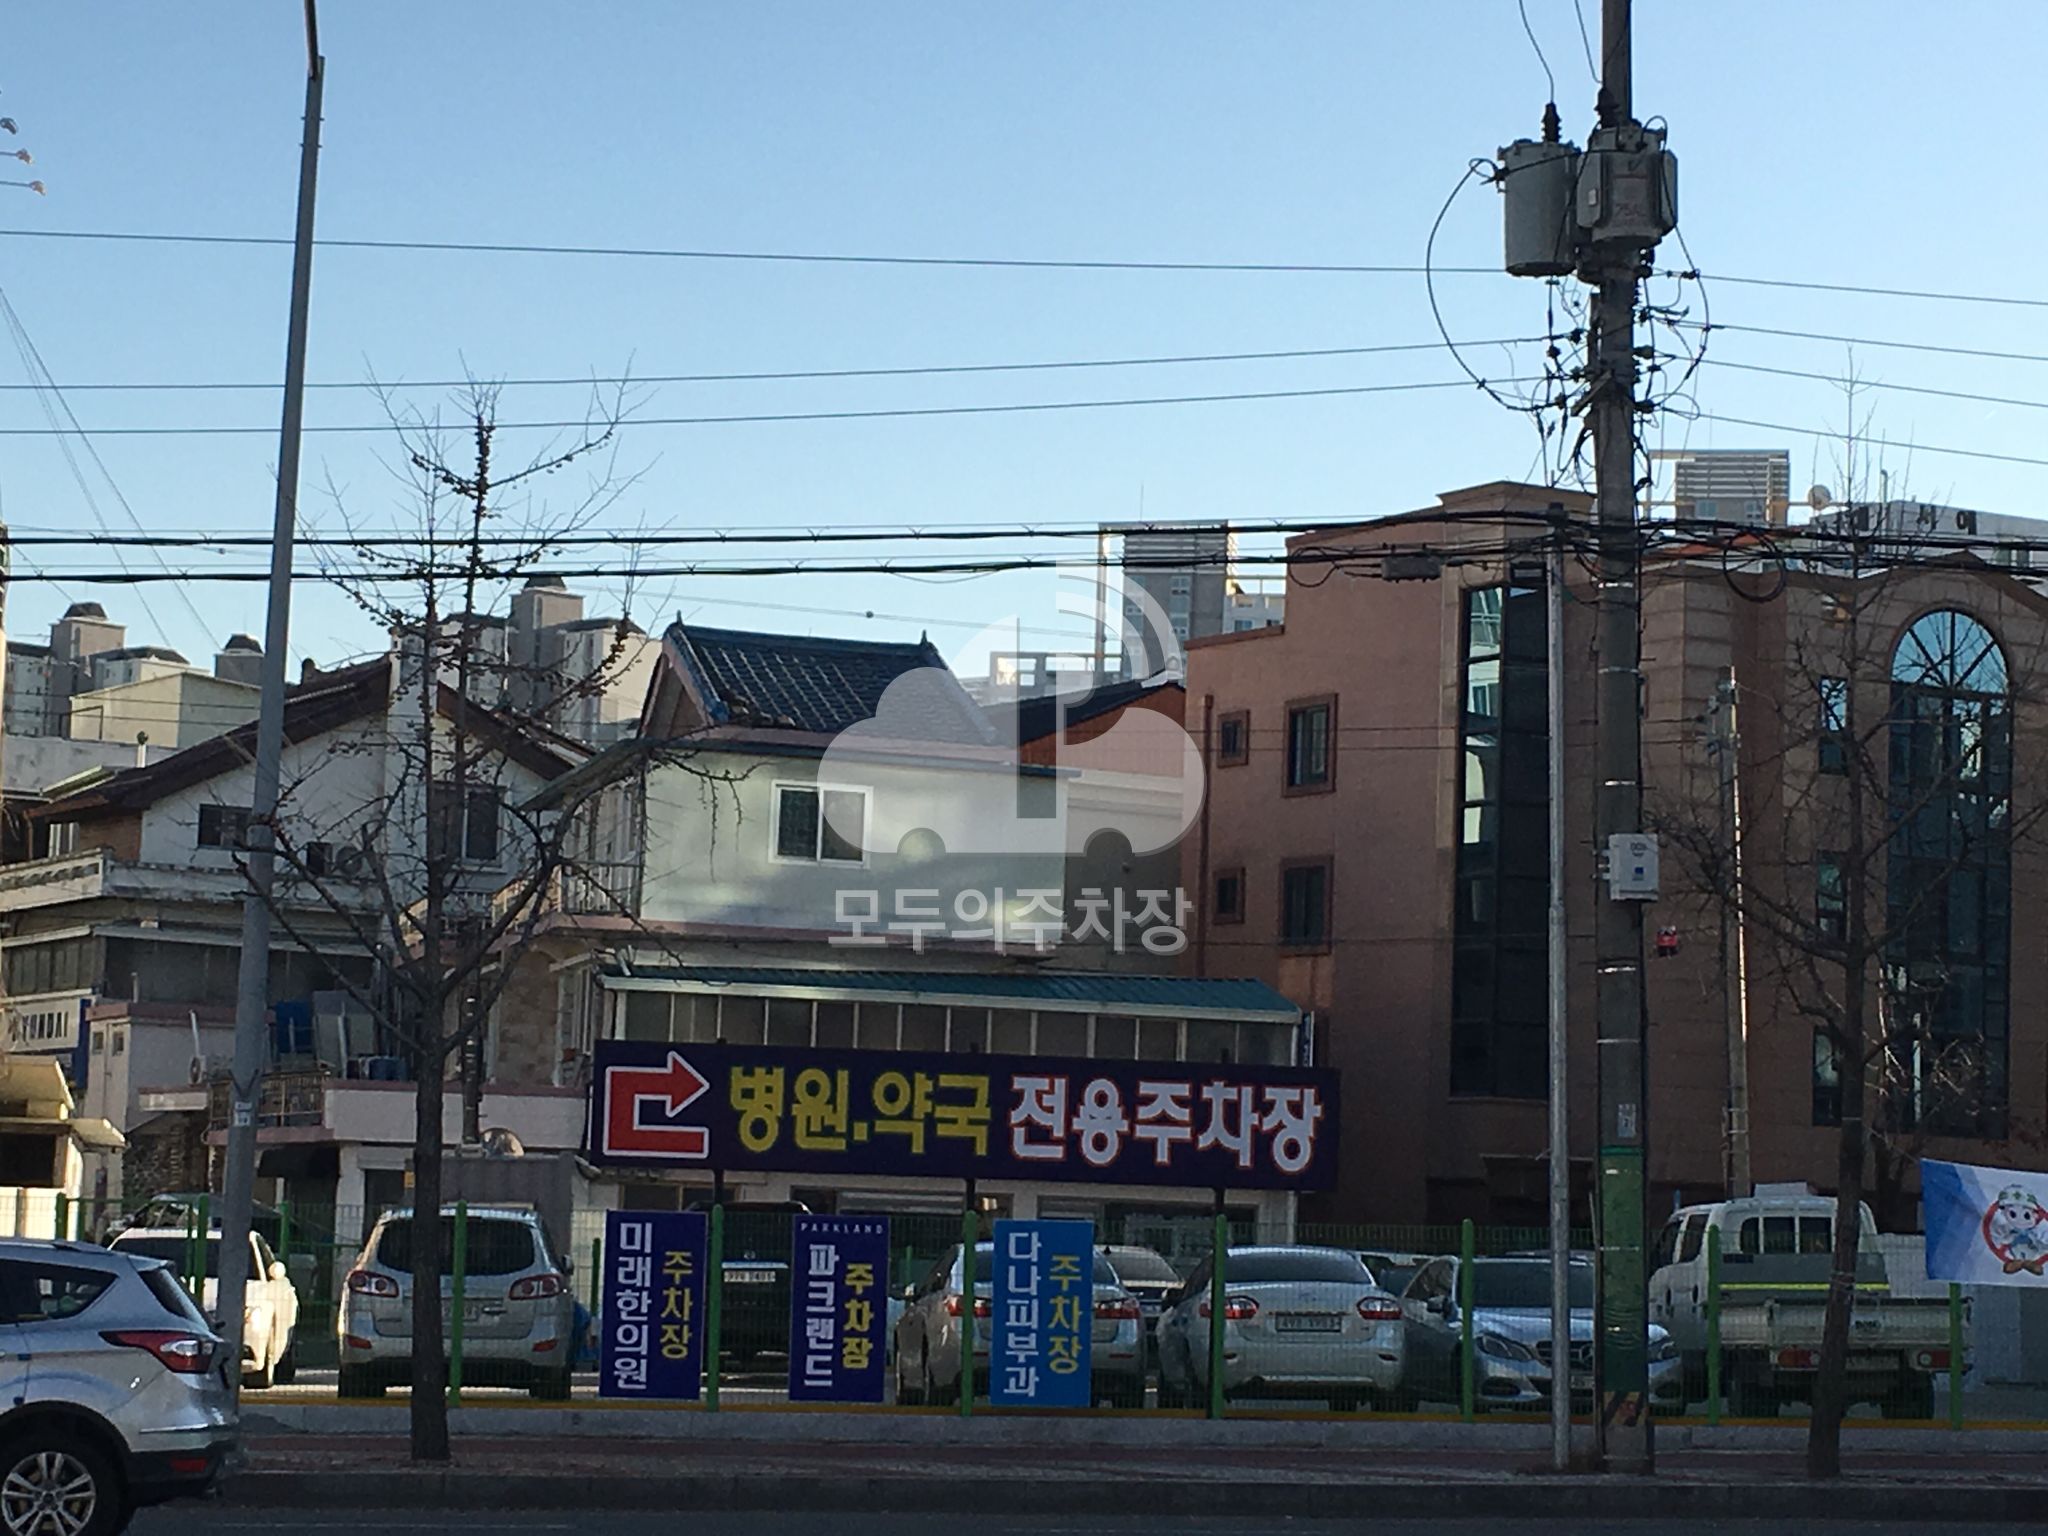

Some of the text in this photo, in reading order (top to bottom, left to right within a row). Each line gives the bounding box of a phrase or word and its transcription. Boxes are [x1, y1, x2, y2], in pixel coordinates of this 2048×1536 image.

[729, 1065, 1324, 1174] 병원.약국 전용주차장
[800, 1223, 884, 1235] PARKLAND
[613, 1222, 653, 1390] 미래한의원
[660, 1251, 693, 1360] 주차장
[804, 1243, 840, 1387] 파크랜드
[843, 1263, 875, 1369] 주차장
[1003, 1231, 1042, 1397] 다나피부과
[1048, 1254, 1083, 1374] 주차장
